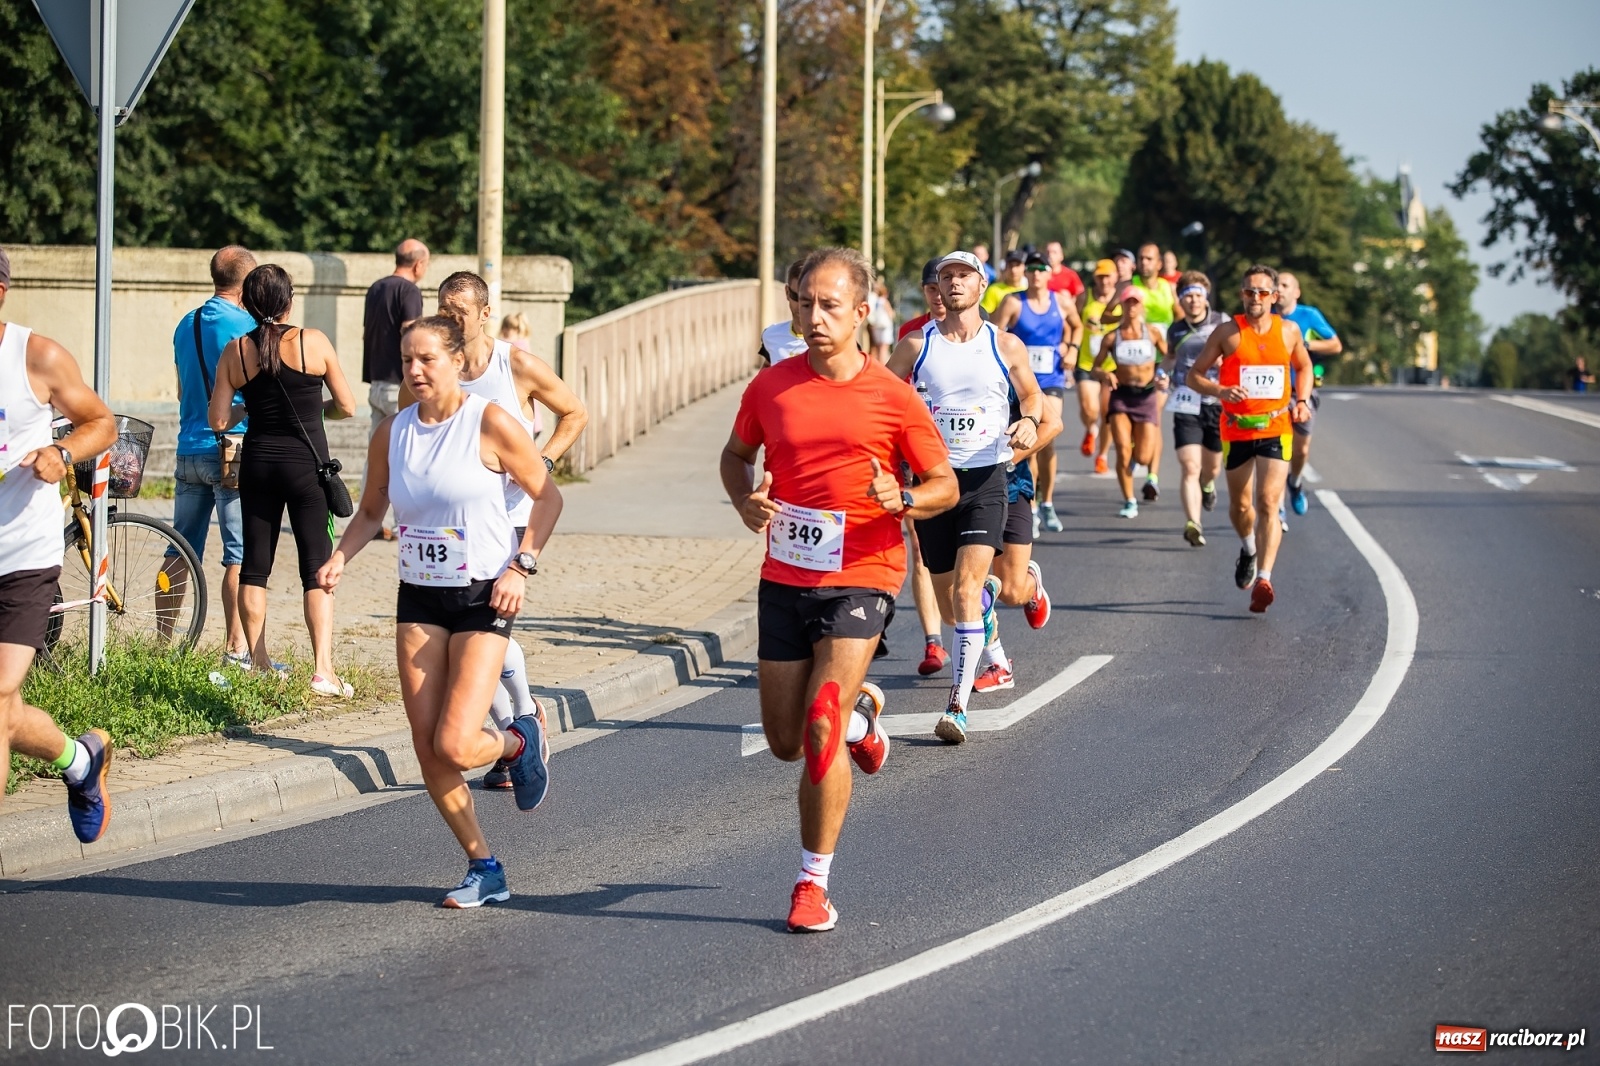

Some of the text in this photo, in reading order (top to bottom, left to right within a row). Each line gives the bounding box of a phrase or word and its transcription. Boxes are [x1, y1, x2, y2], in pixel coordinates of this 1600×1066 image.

[1255, 375, 1275, 385] 179
[949, 417, 976, 431] 159
[788, 521, 823, 546] 349
[417, 542, 448, 563] 143
[957, 636, 971, 691] alenji
